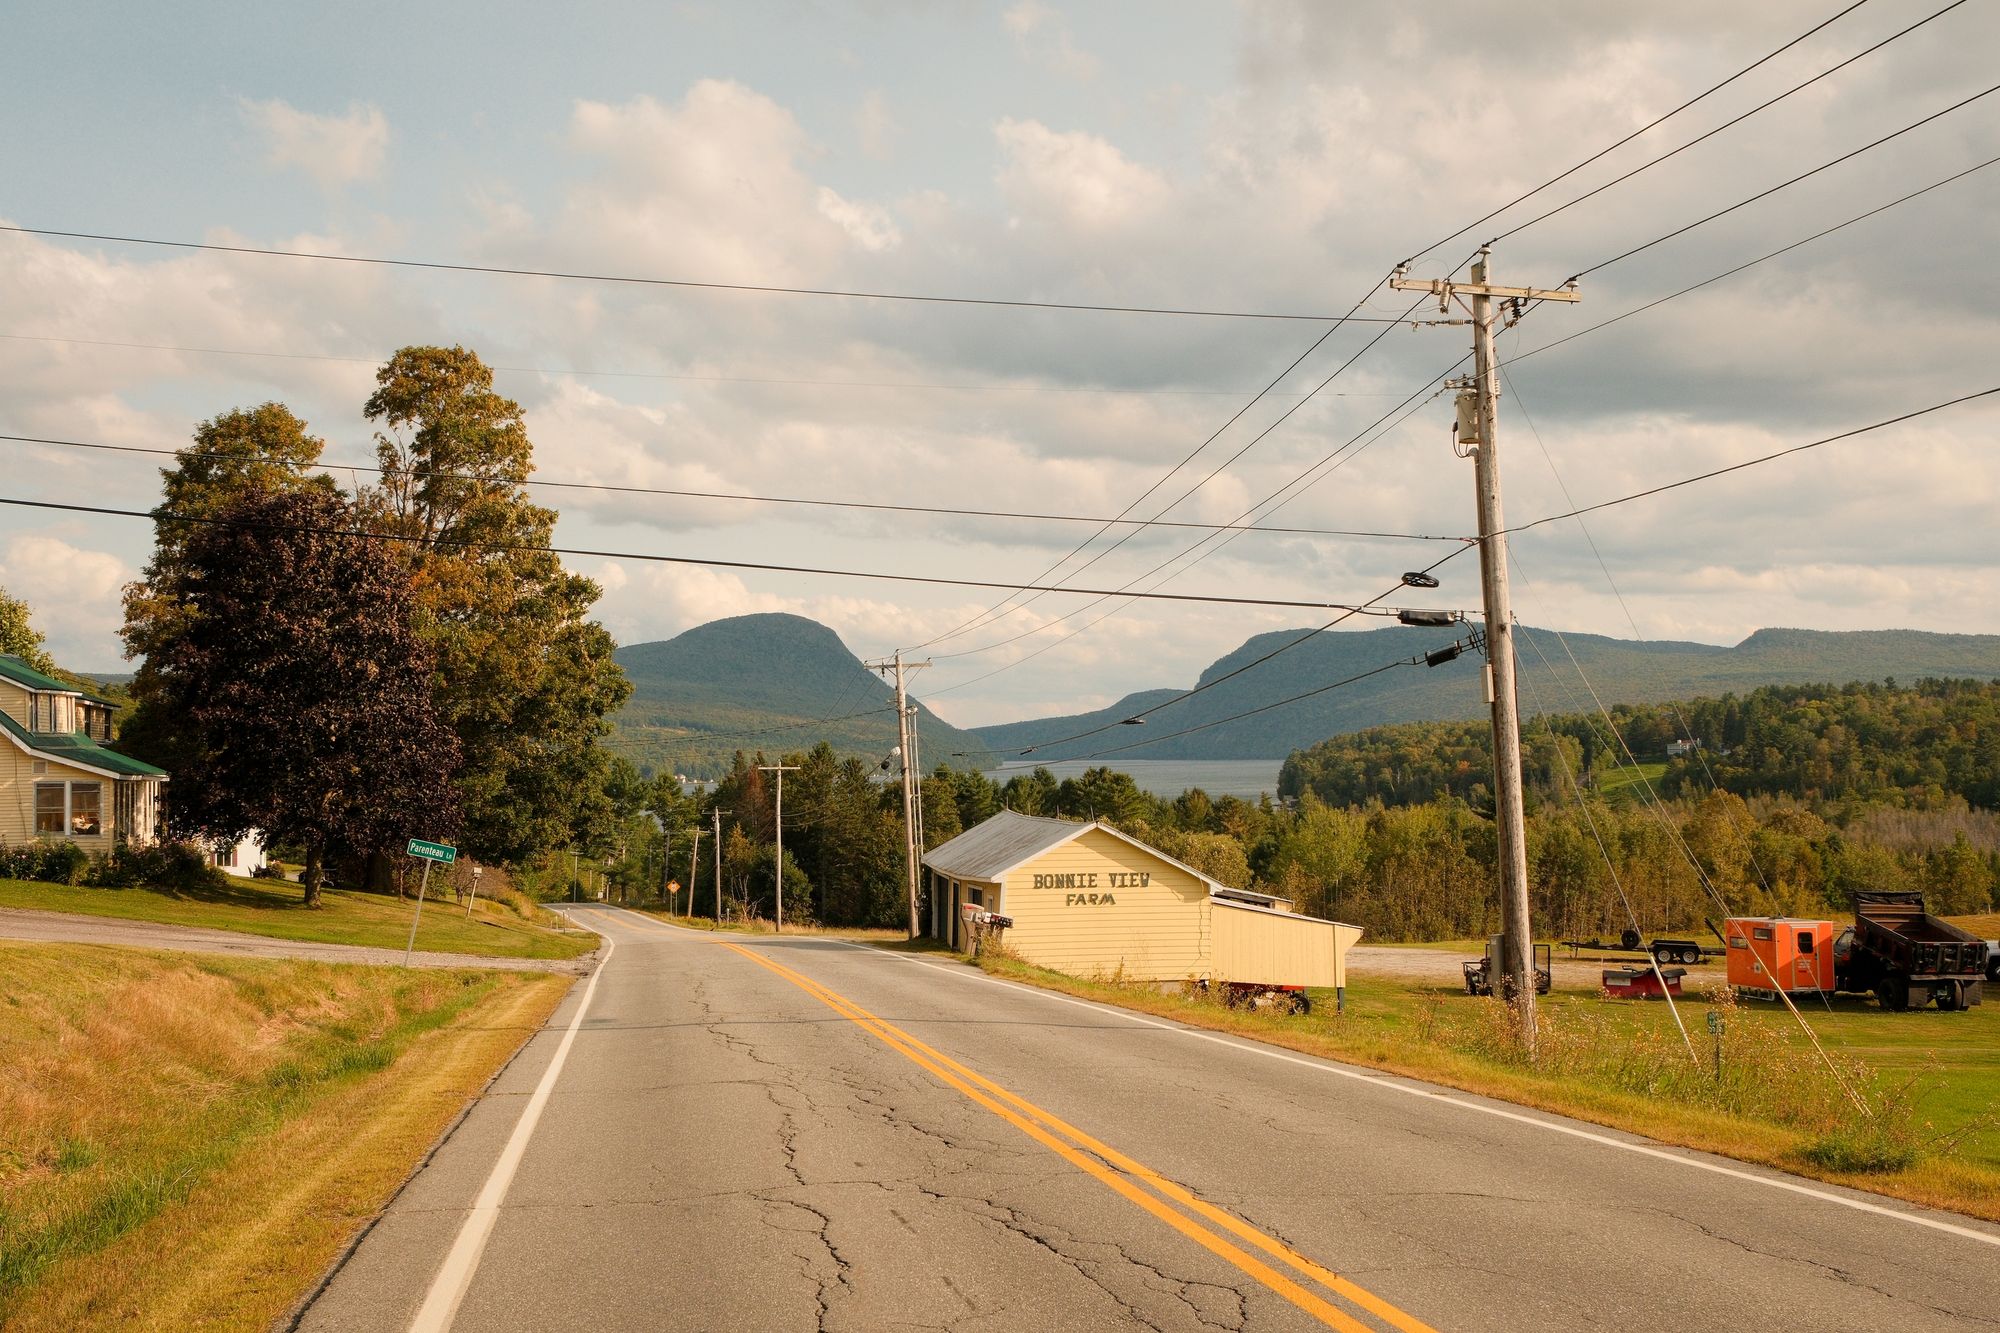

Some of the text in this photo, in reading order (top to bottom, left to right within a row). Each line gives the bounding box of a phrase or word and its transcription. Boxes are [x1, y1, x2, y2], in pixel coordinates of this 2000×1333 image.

[410, 842, 453, 860] Parenteau Ln
[1033, 873, 1150, 889] BONNIE VIEW
[1066, 893, 1116, 906] FARM
